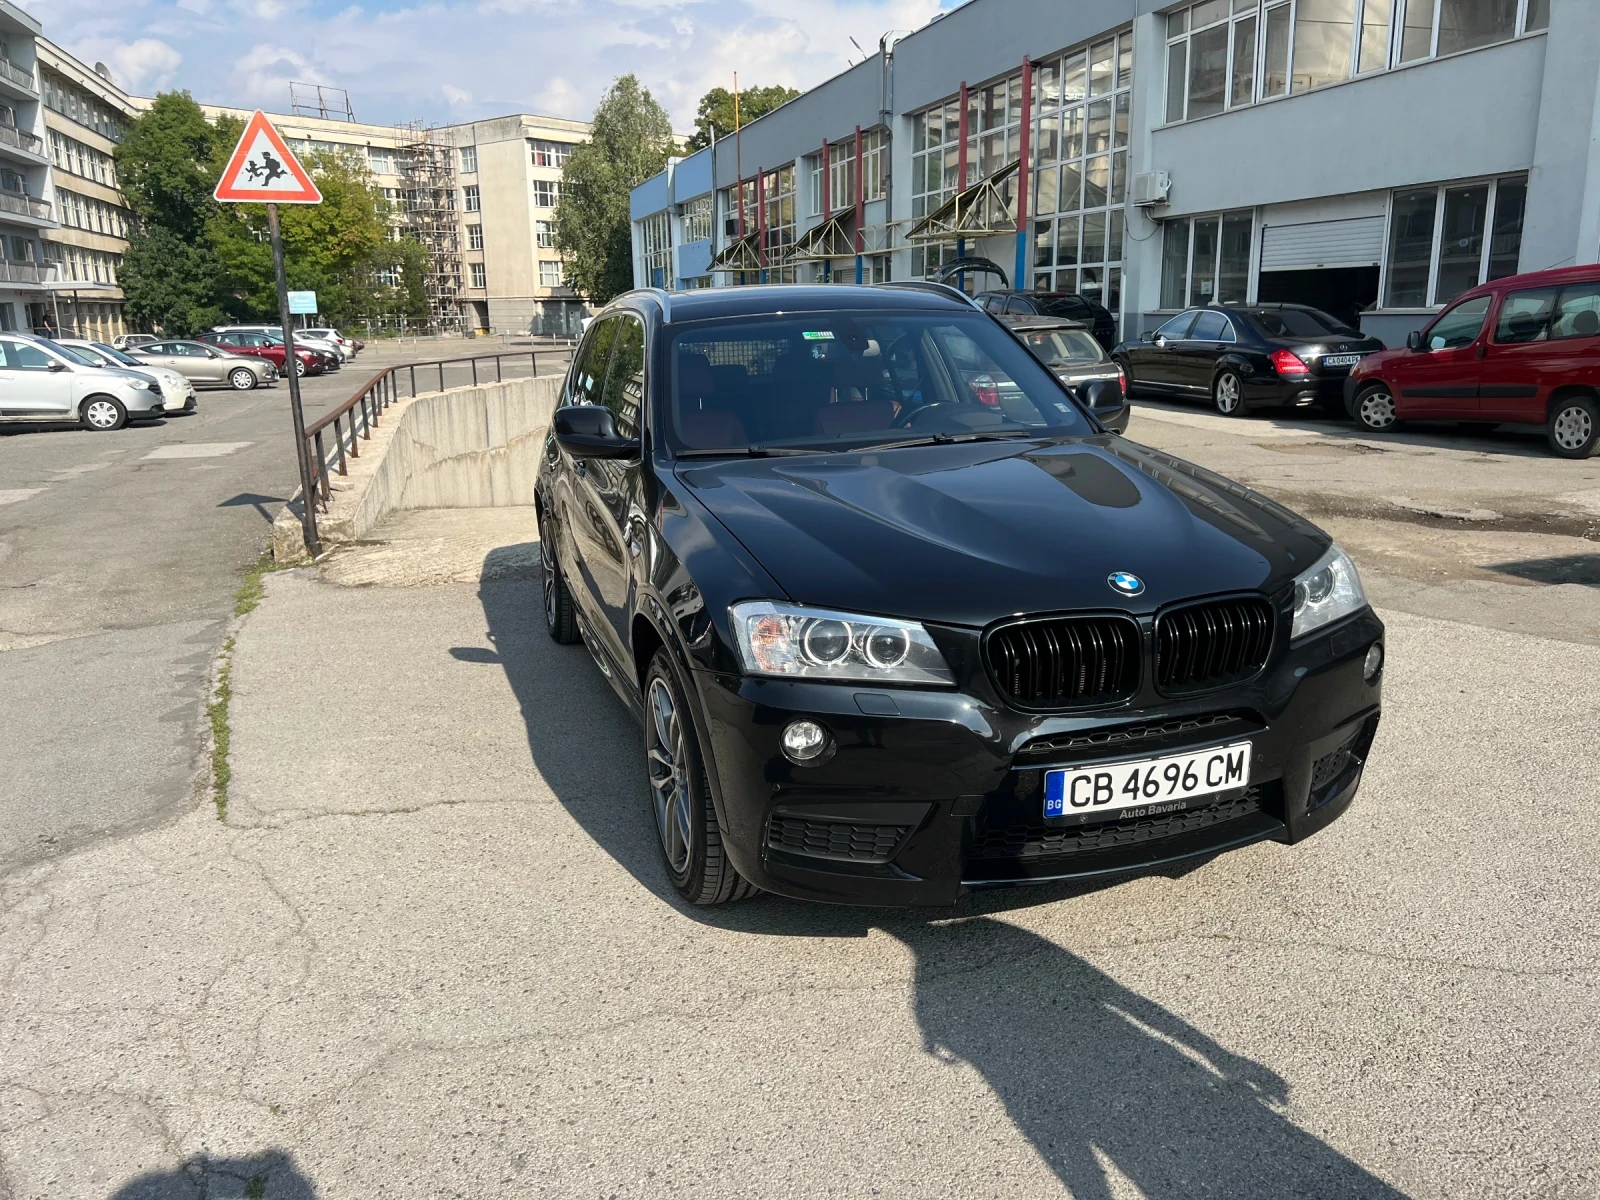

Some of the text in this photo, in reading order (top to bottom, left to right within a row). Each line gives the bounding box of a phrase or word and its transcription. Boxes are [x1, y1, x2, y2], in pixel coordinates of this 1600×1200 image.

[1070, 750, 1245, 808] CB 4696 CM
[1047, 799, 1062, 810] BG
[1119, 801, 1187, 819] Auto Bavaria
